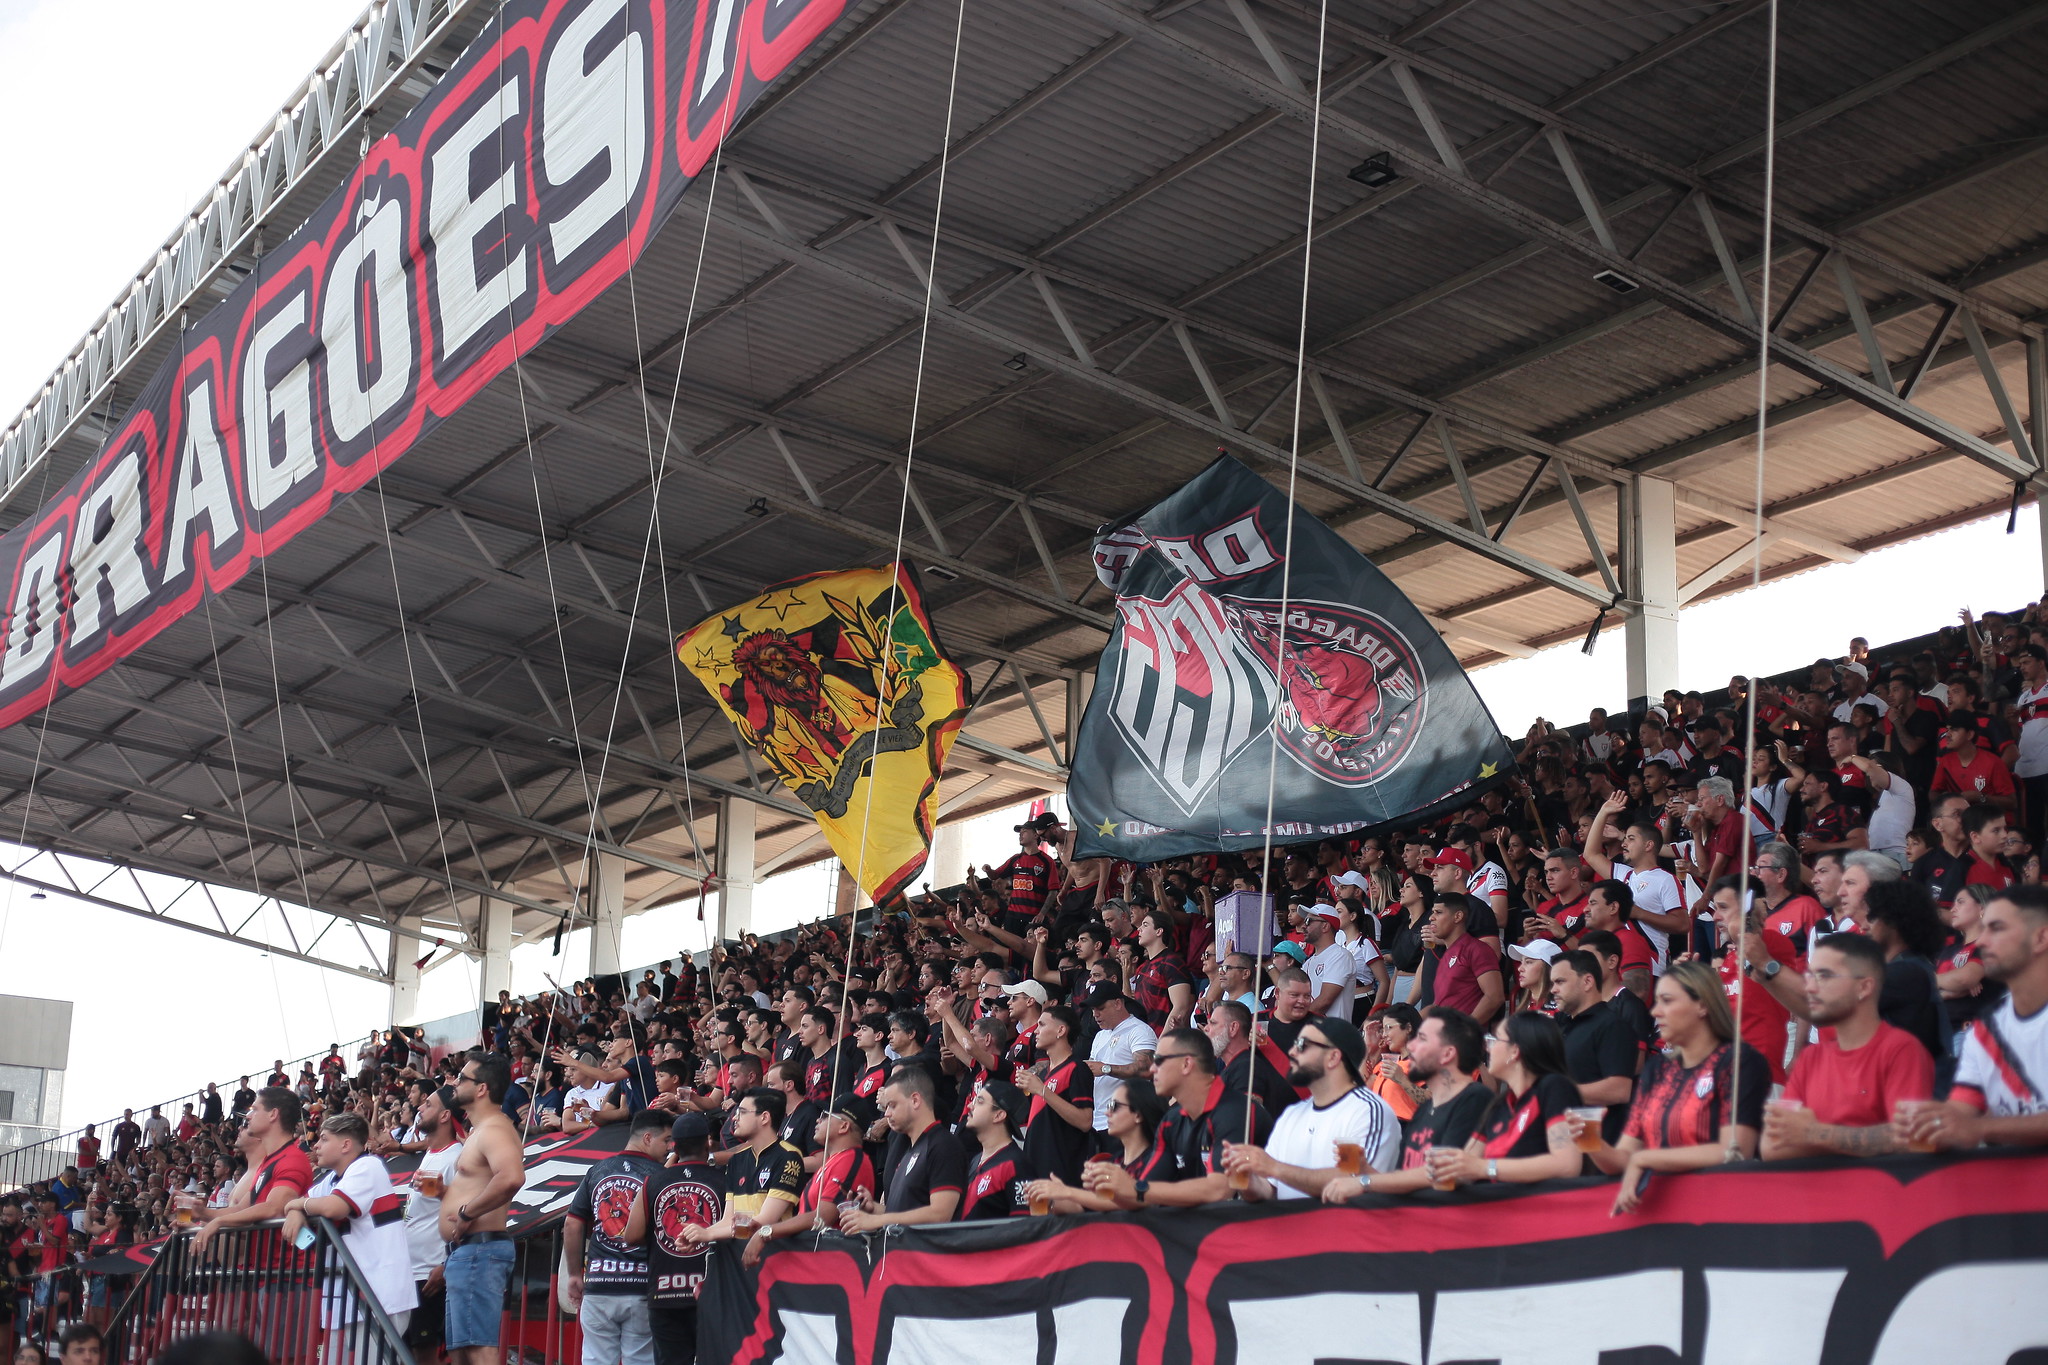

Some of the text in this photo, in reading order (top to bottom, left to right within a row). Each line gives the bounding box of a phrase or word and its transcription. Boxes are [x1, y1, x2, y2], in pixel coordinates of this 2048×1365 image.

[0, 0, 646, 690] DRAGÕES
[888, 734, 904, 743] VIER
[1013, 879, 1034, 891] BMG
